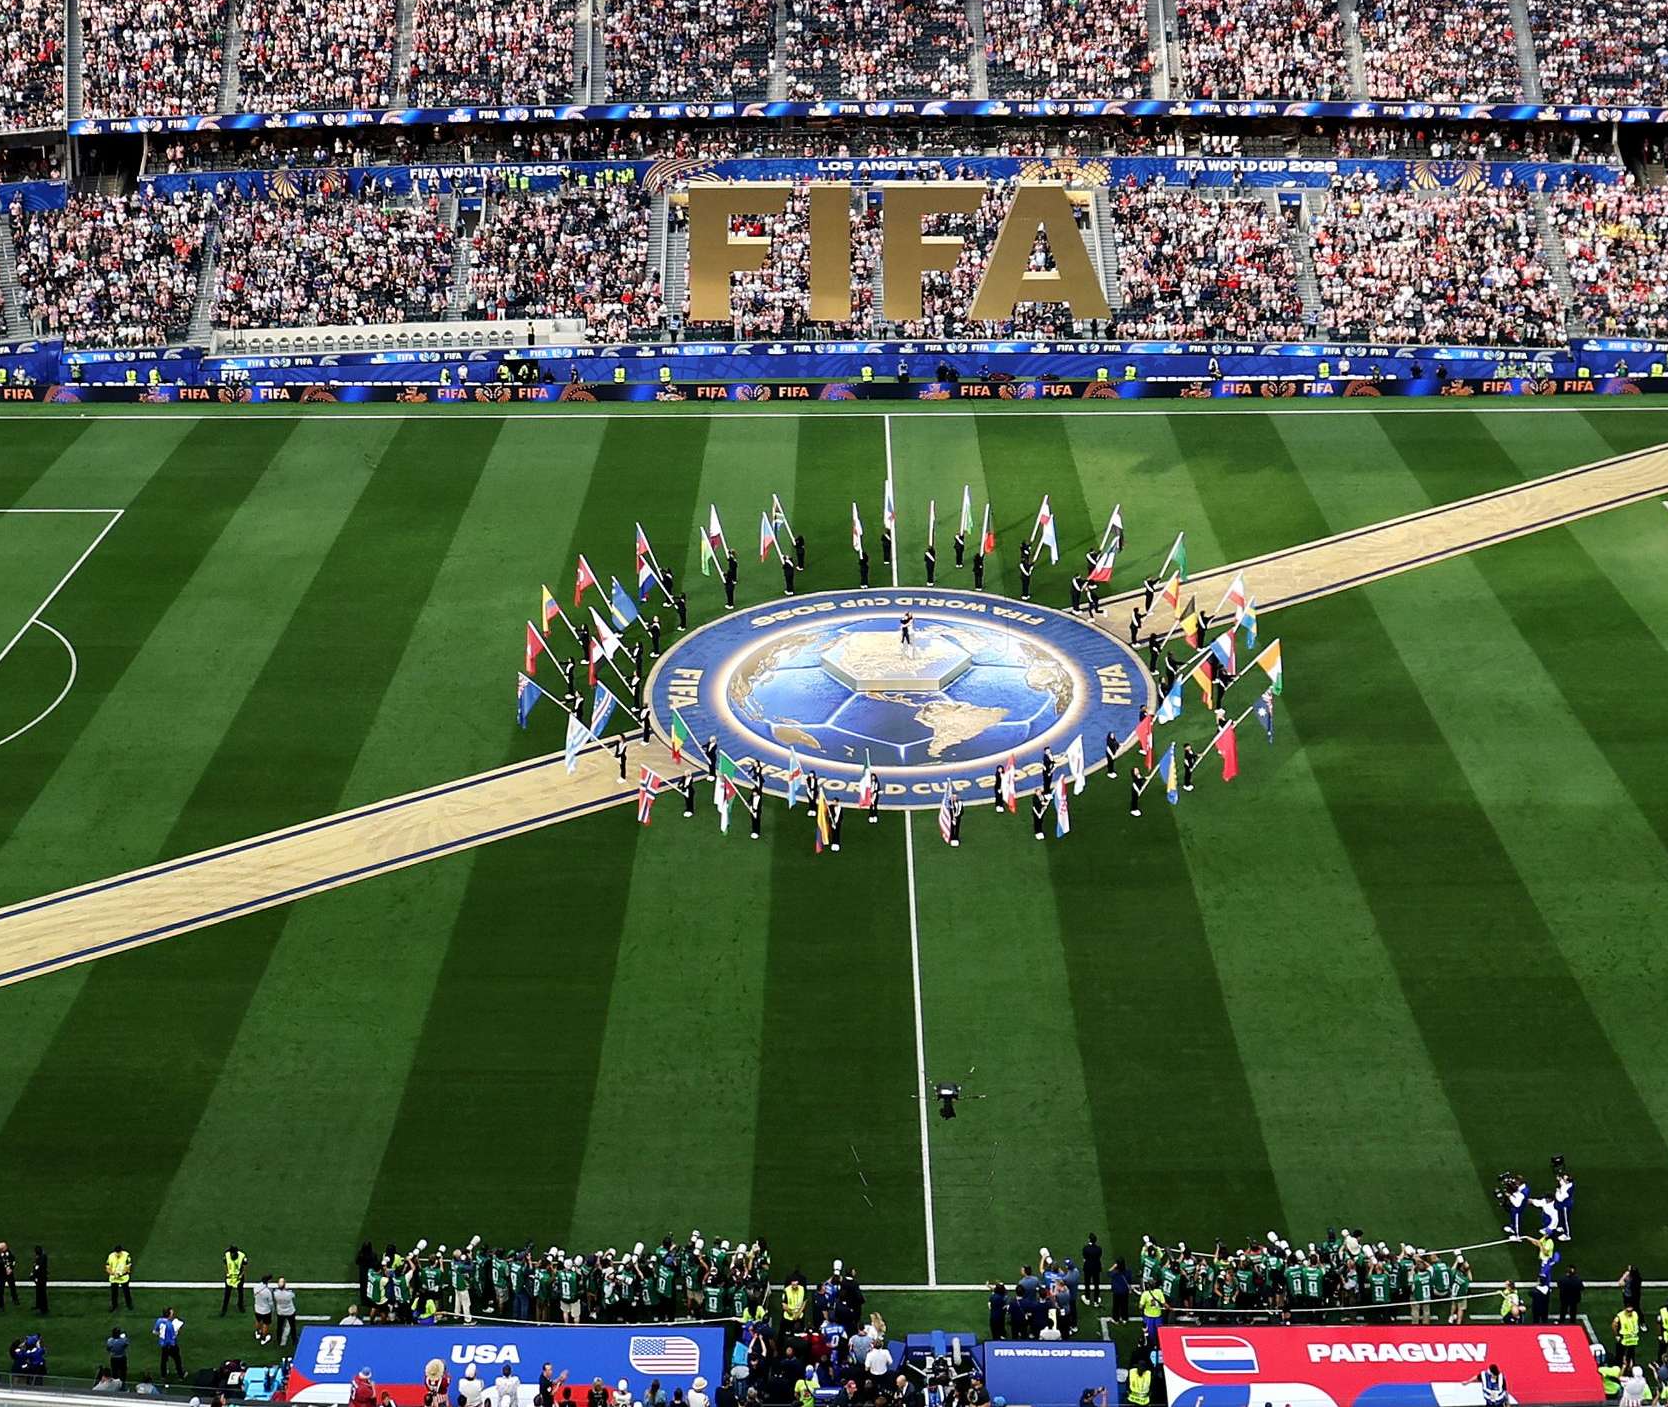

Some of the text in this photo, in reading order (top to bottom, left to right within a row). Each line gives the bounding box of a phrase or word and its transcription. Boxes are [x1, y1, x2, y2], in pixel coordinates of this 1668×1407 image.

[659, 107, 679, 116] FIFA
[1074, 104, 1094, 113] FIFA
[480, 110, 499, 120] FIFA
[111, 122, 131, 132] FIFA
[818, 161, 940, 171] LOS ANGELES
[1176, 160, 1206, 171] FIFA
[1259, 161, 1287, 172] CUP
[1289, 161, 1338, 172] 2026
[410, 168, 439, 179] FIFA
[522, 165, 570, 176] 2026
[688, 181, 1113, 321] FIFA
[1057, 344, 1074, 352] FIFA
[1236, 345, 1253, 353] FIFA
[1609, 342, 1626, 350] FIFA
[577, 348, 594, 357] FIFA
[1509, 352, 1526, 360] FIFA
[961, 385, 990, 396] FIFA
[1042, 385, 1071, 396] FIFA
[1222, 384, 1251, 395] FIFA
[1303, 383, 1332, 394] FIFA
[1483, 381, 1512, 392] FIFA
[1564, 381, 1594, 392] FIFA
[3, 388, 33, 400] FIFA
[180, 388, 209, 400] FIFA
[260, 388, 289, 400] FIFA
[438, 388, 466, 400] FIFA
[519, 388, 548, 399] FIFA
[697, 387, 727, 398] FIFA
[779, 387, 808, 398] FIFA
[750, 597, 1047, 627] FIFA WORLD CUP 2026
[668, 667, 704, 710] FIFA
[1096, 664, 1132, 704] FIFA
[736, 756, 791, 780] FFA
[802, 776, 907, 794] ORD
[912, 779, 971, 794] CUP
[451, 1344, 521, 1364] USA
[994, 1349, 1105, 1359] FIFA WORLD CUP 2026
[1307, 1343, 1487, 1362] PARAGUAY
